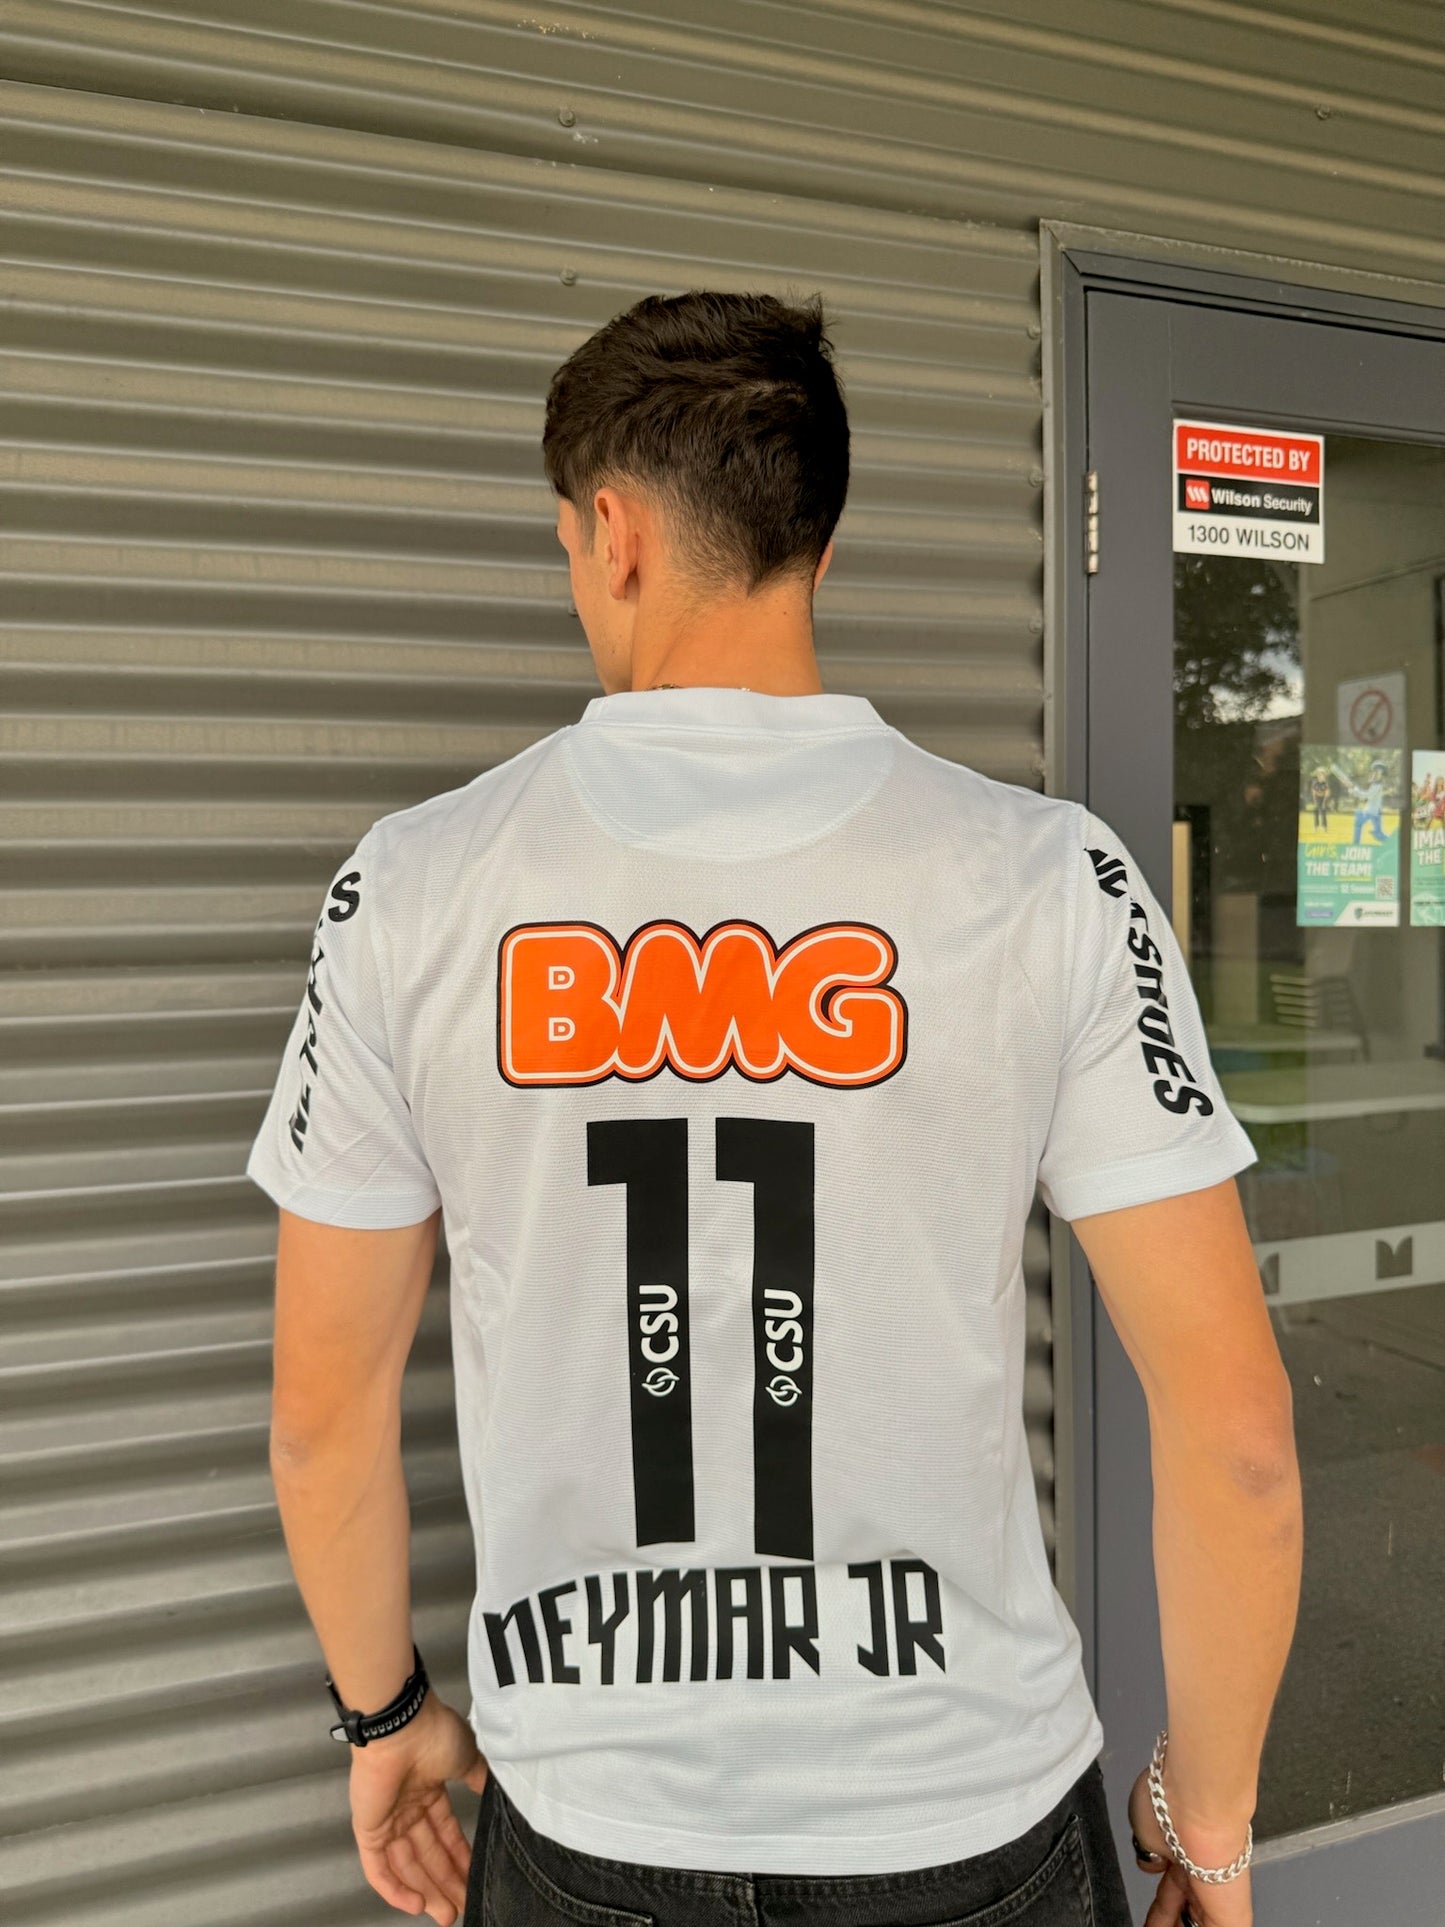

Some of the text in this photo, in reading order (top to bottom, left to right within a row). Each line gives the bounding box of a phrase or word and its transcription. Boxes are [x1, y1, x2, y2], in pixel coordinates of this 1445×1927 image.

[1186, 438, 1311, 472] PROTECTED BY
[1211, 487, 1313, 516] Wilson Security
[1188, 525, 1310, 551] 1300 WILSON
[1305, 862, 1372, 877] THE TEAM!
[1341, 846, 1372, 861] JOIN
[1417, 849, 1440, 866] THE
[498, 919, 908, 1090] BMG
[587, 1117, 815, 1561] 11
[639, 1284, 680, 1363] CSU
[764, 1288, 804, 1372] CSU
[483, 1559, 946, 1688] NEYMAR JR
